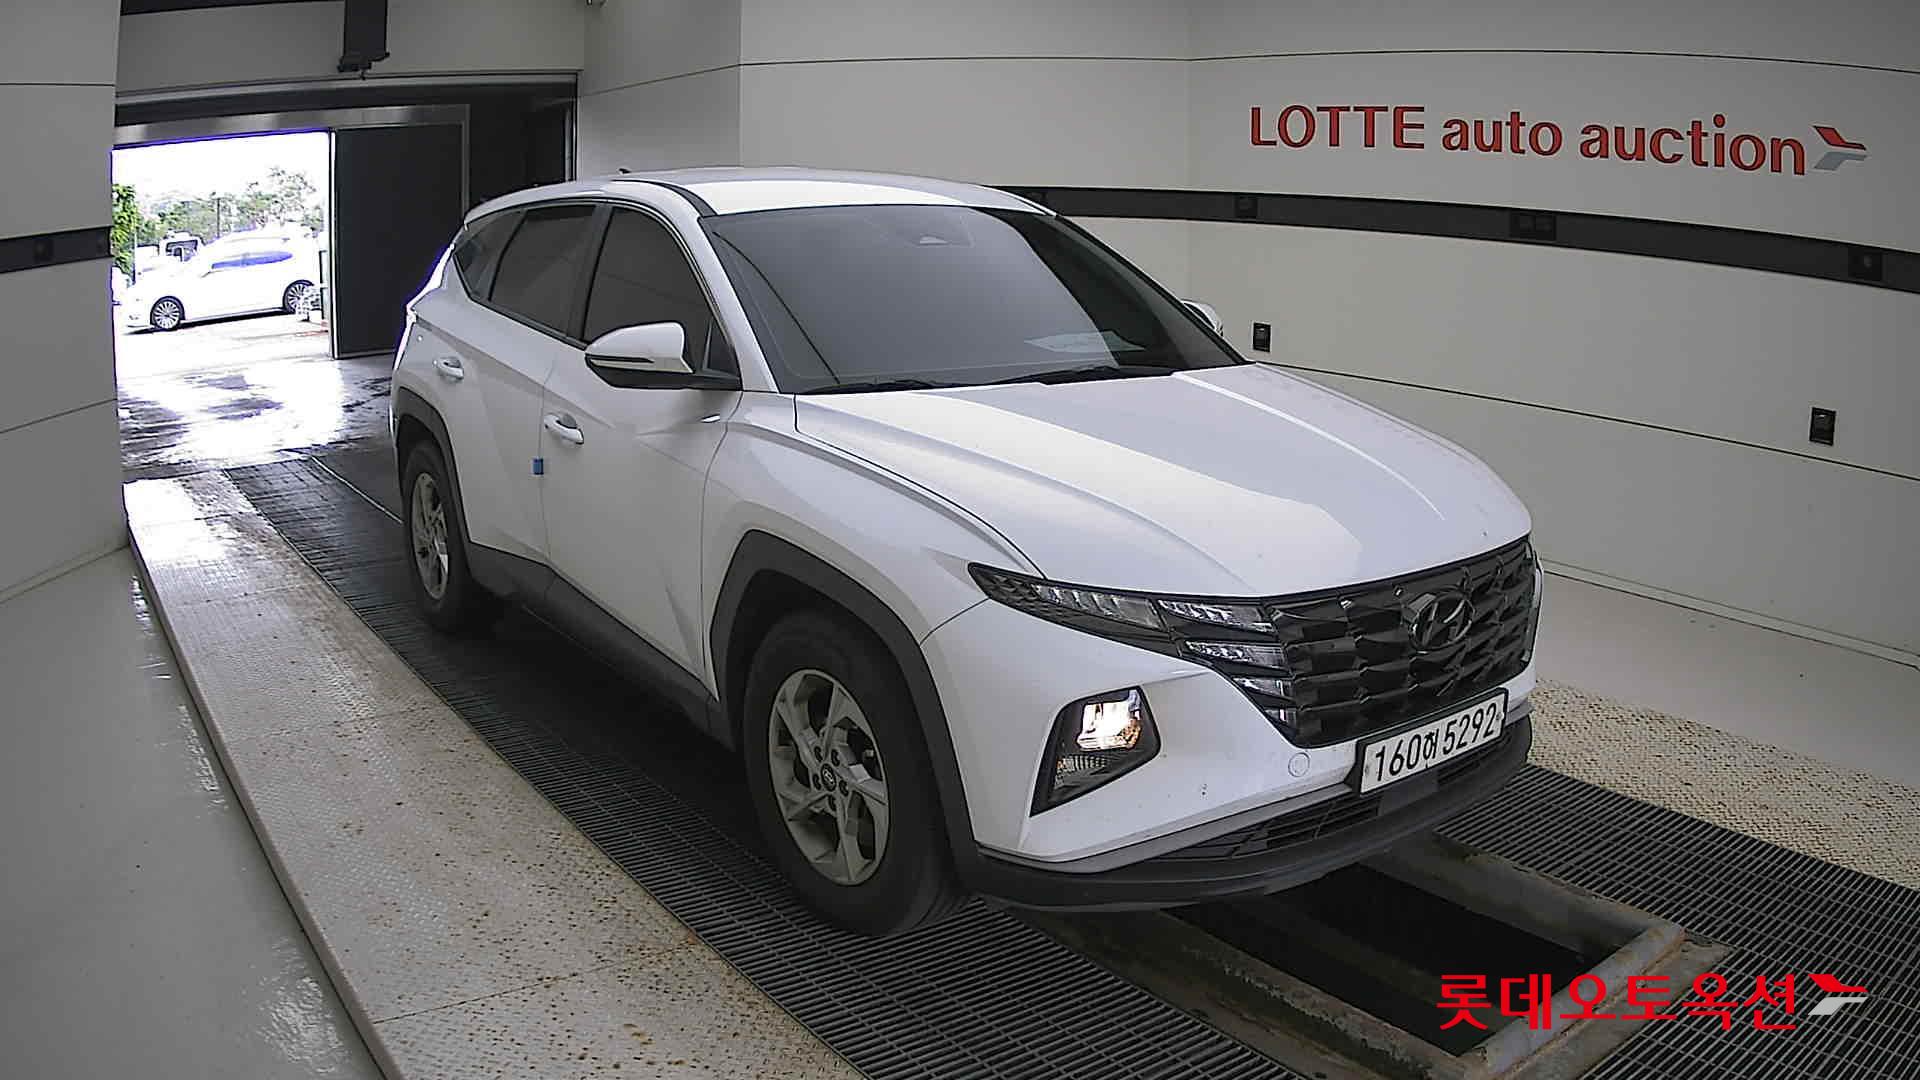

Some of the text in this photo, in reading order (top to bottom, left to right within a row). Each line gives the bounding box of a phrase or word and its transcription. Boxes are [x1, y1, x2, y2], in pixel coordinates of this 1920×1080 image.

[1249, 104, 1806, 175] LOTTE auto auction
